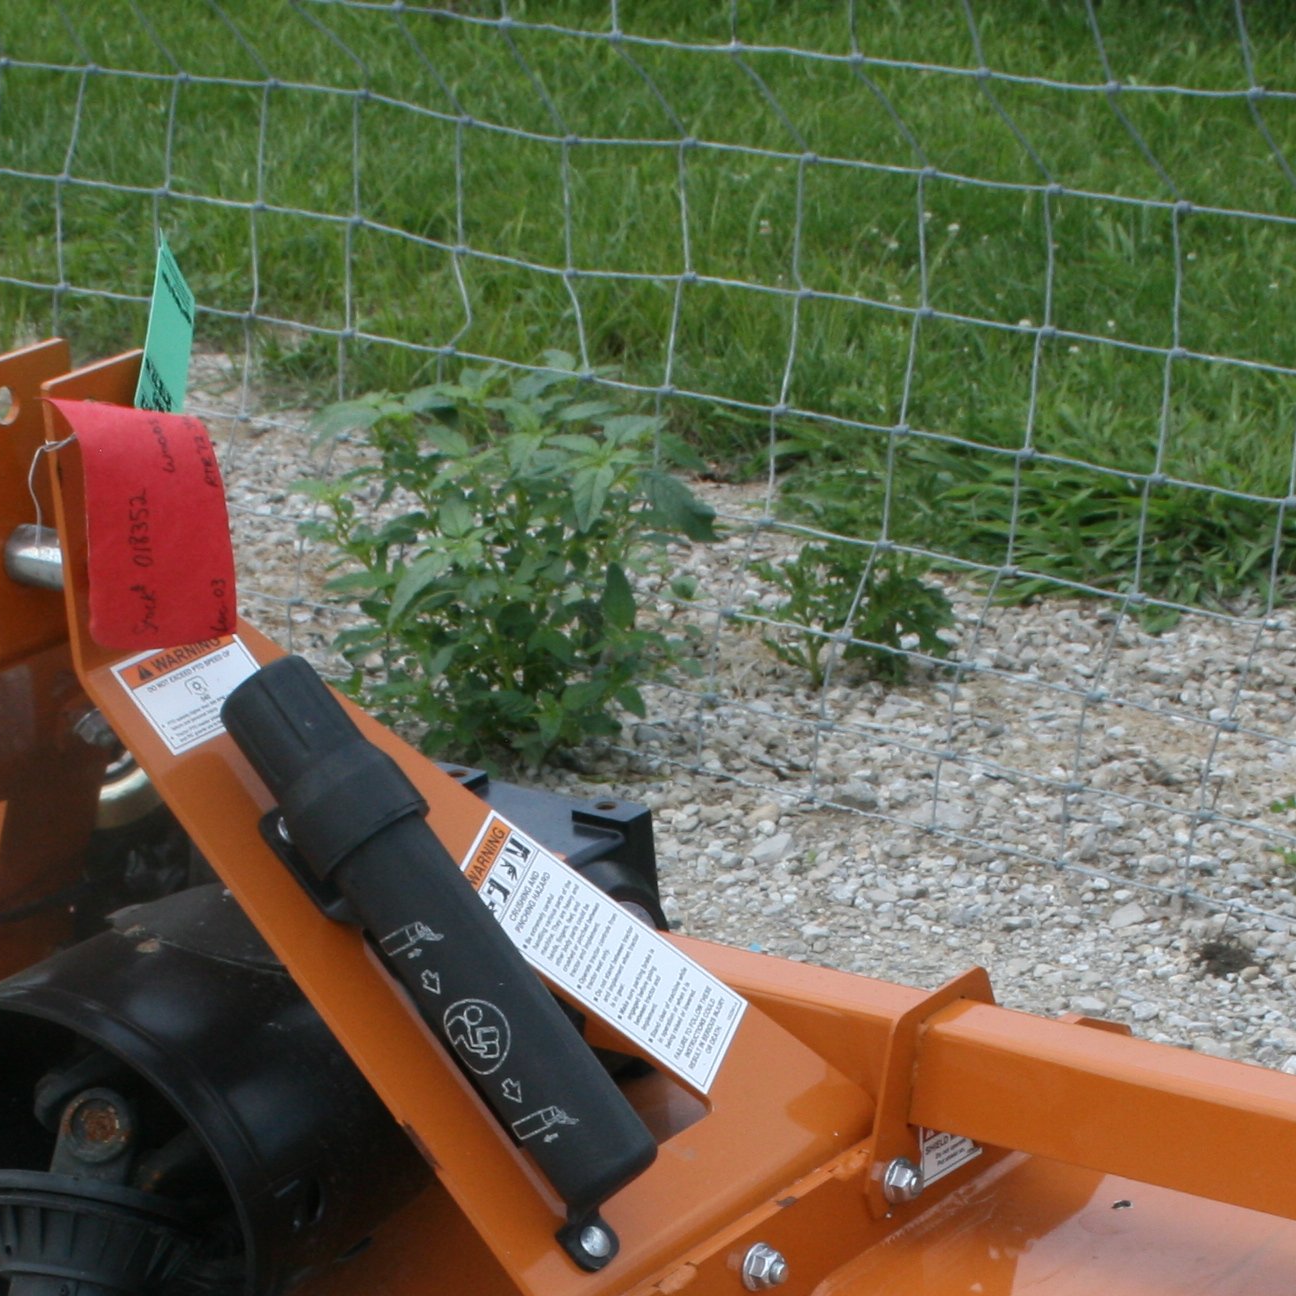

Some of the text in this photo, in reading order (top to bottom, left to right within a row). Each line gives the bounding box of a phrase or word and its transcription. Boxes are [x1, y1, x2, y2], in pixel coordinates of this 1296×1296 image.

[128, 488, 154, 568] 018352
[152, 637, 222, 672] WARNING
[468, 825, 505, 887] WARNING
[509, 869, 539, 921] CRUSHING AND
[515, 871, 550, 933] PINCHING HAZARD
[674, 985, 711, 1060] FAILURE TO FOLLOW THESE
[684, 997, 715, 1058] INSTRUCTIONS COULD
[705, 1044, 712, 1054] OR
